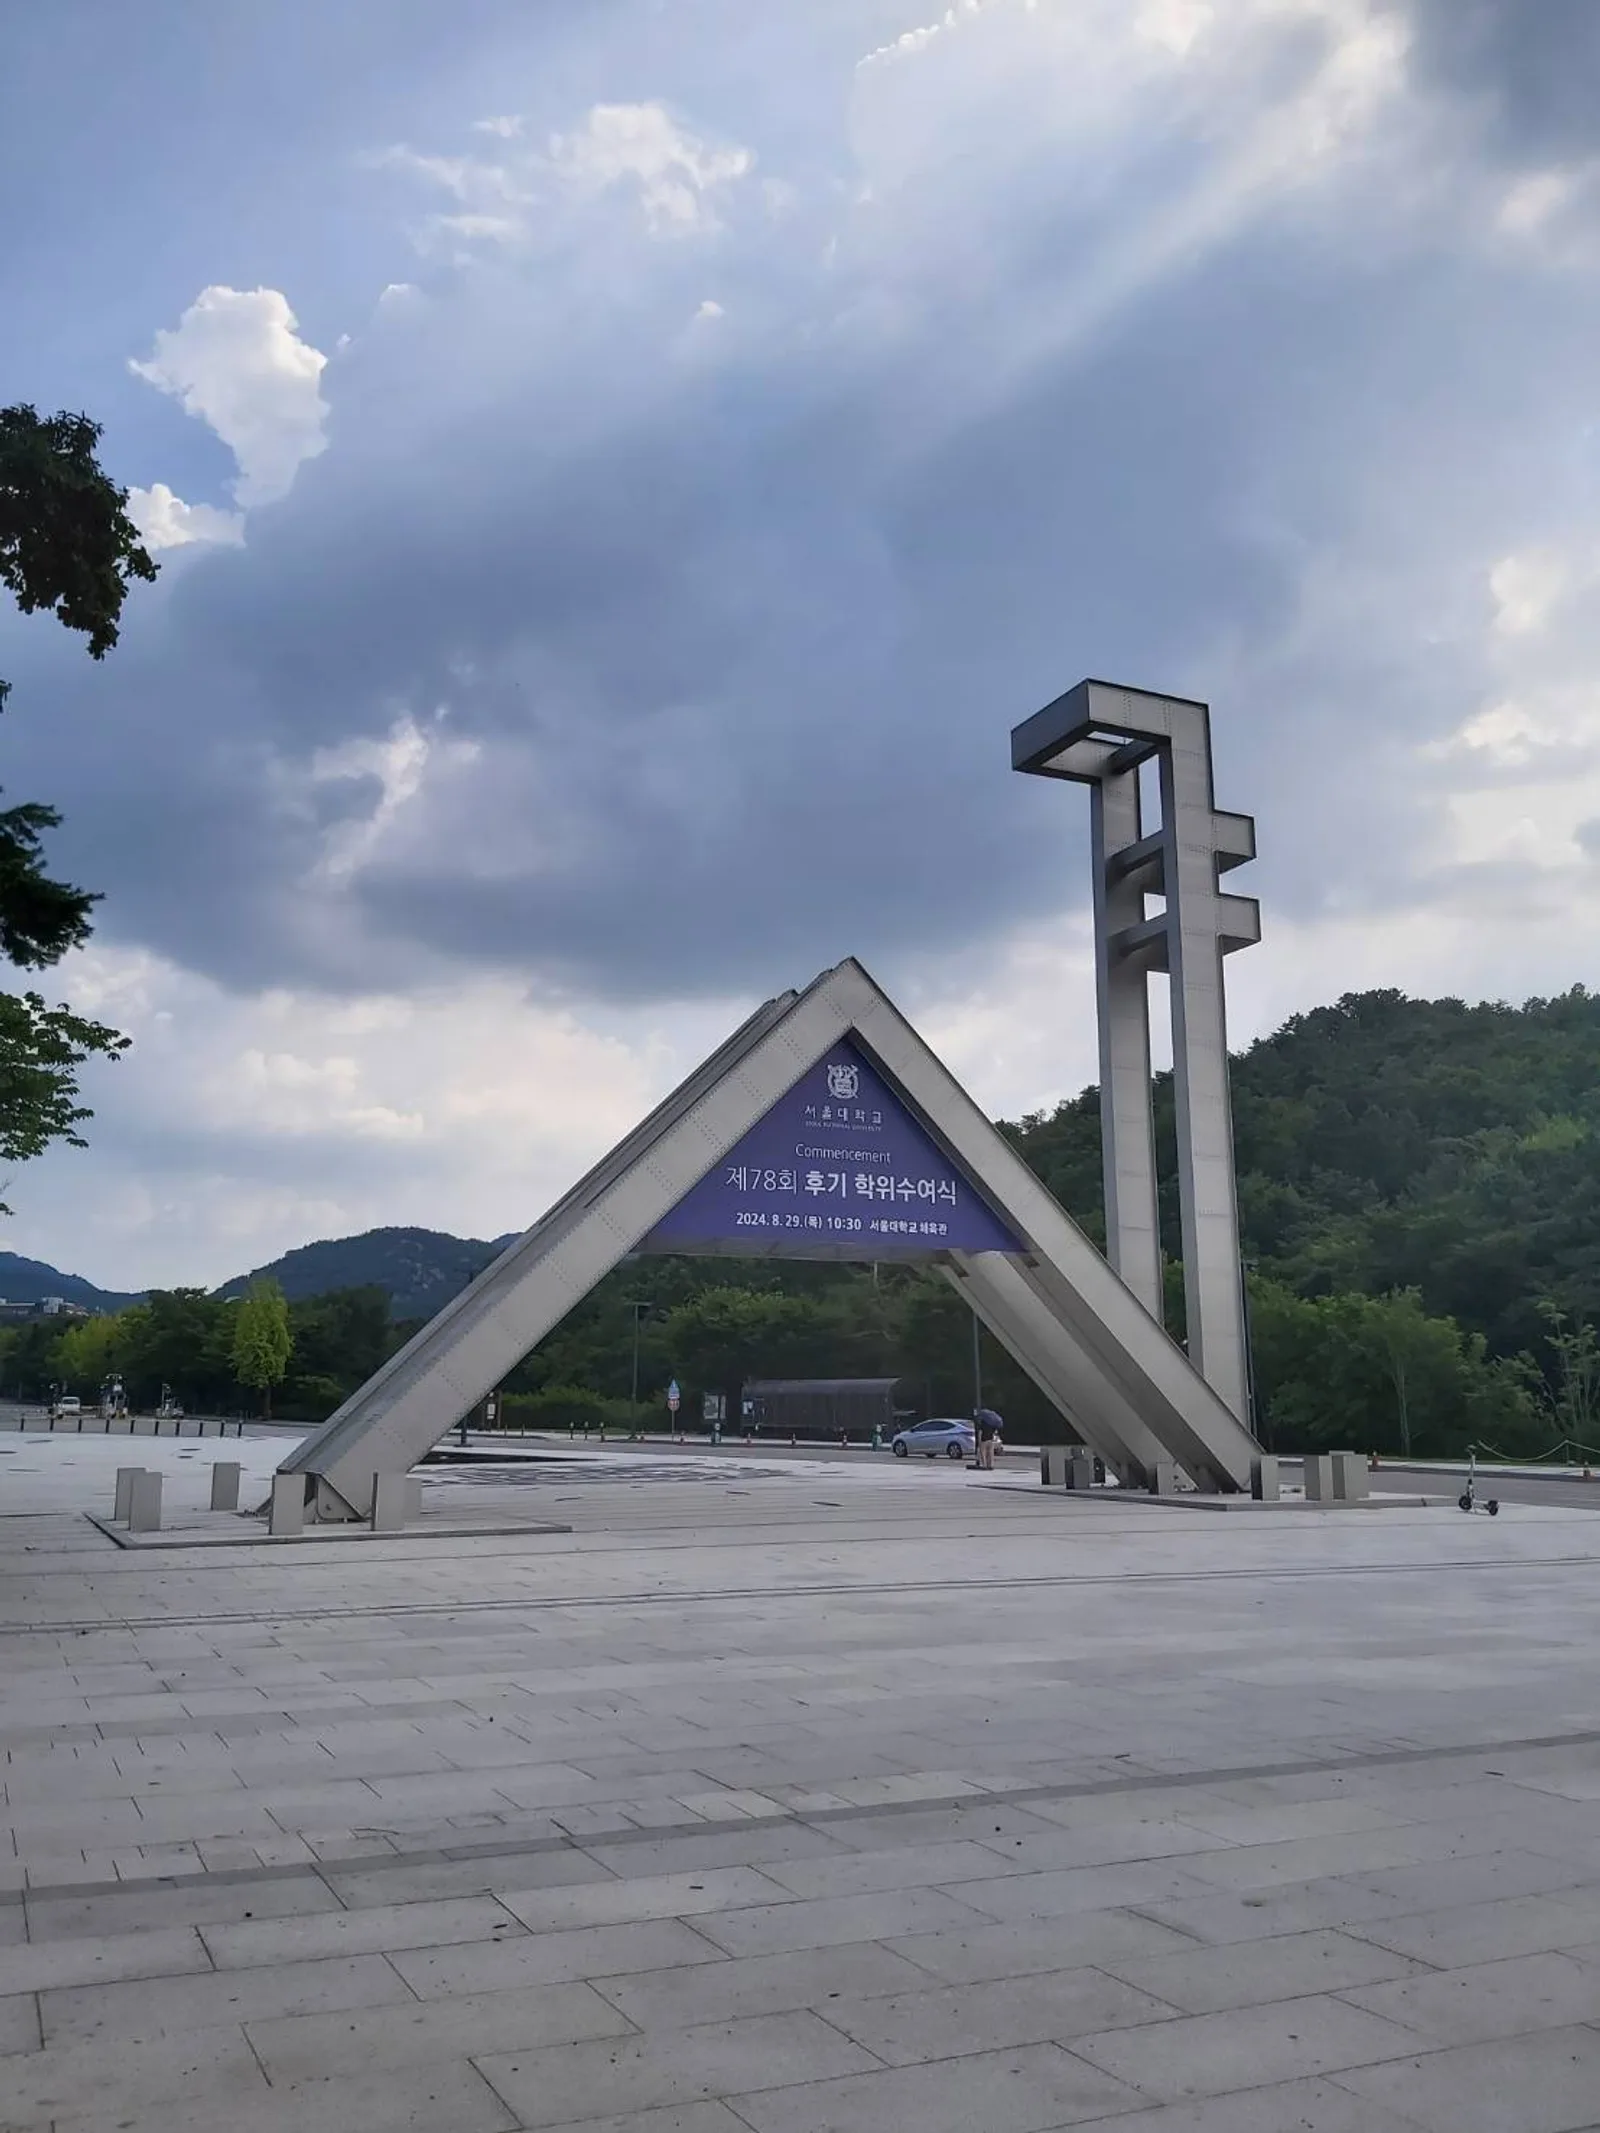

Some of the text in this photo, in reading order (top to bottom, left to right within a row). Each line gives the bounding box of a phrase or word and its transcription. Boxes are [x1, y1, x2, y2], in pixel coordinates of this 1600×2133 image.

[804, 1104, 882, 1124] 서울대학교
[795, 1143, 891, 1164] Commencement
[725, 1166, 957, 1206] 제78회 후기 학위수여식
[827, 1217, 862, 1230] 10:30
